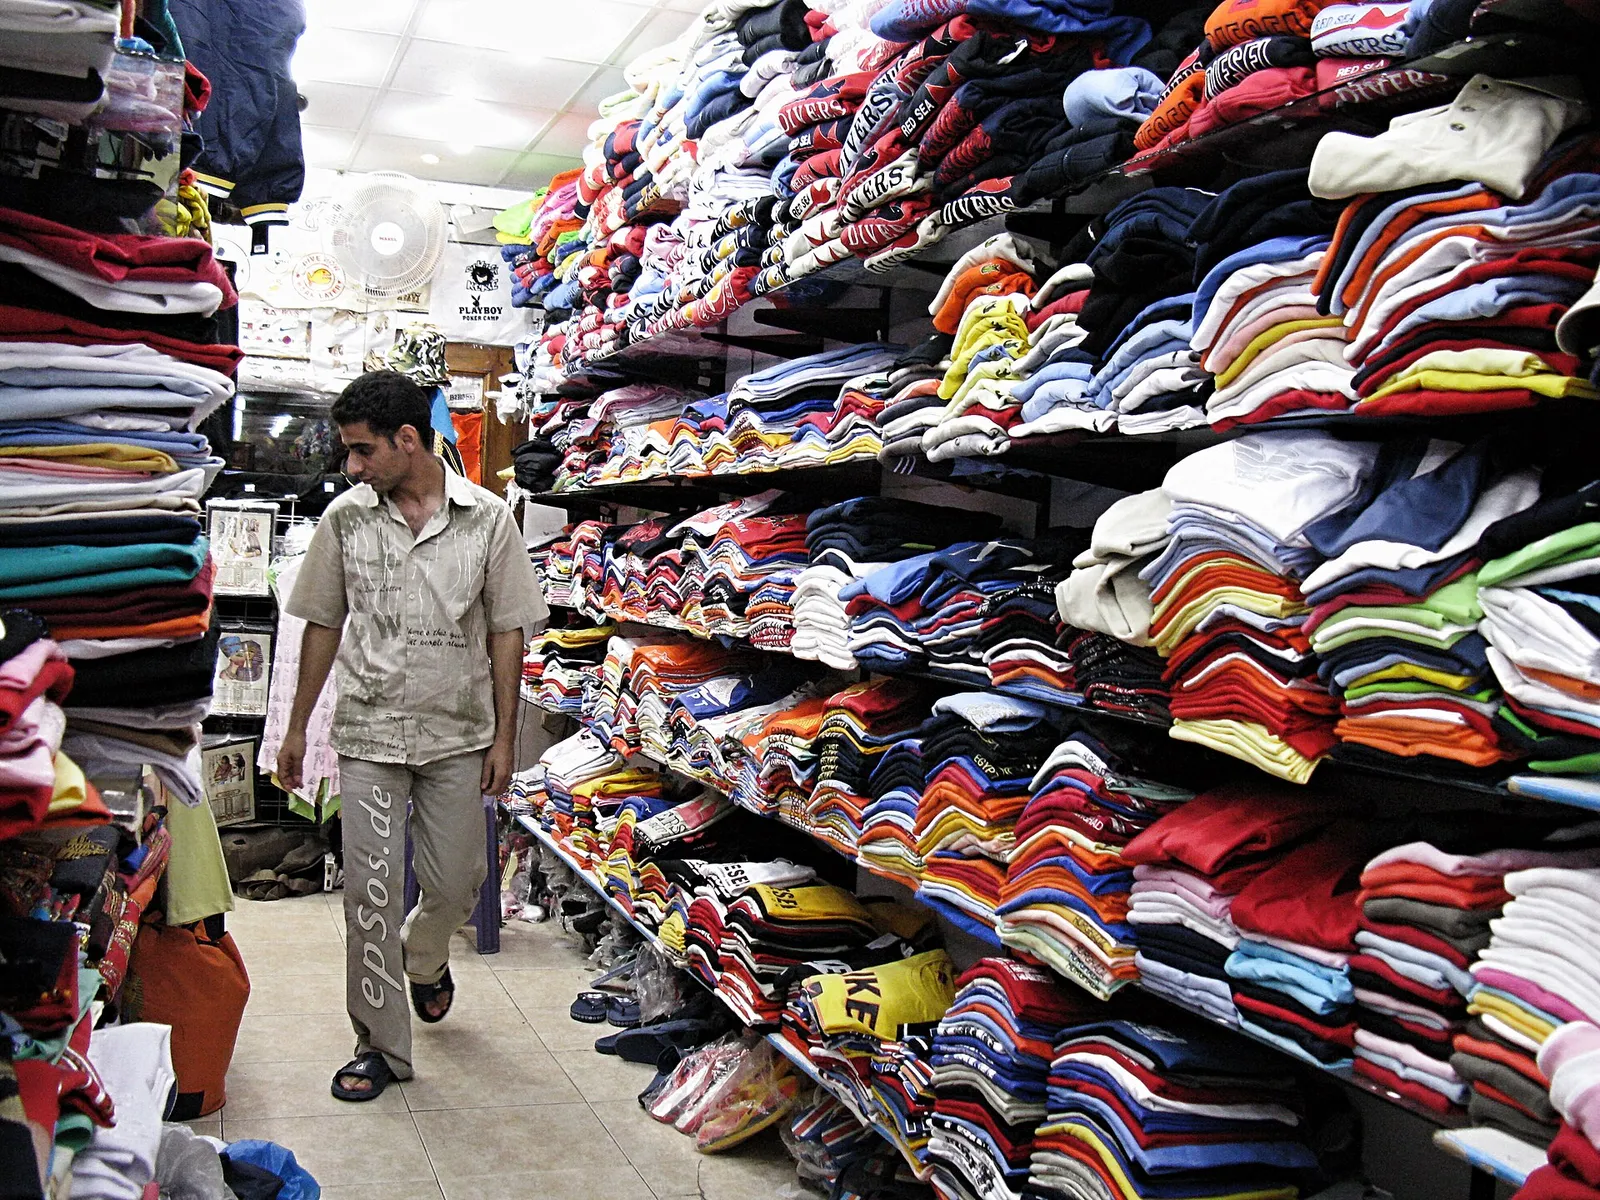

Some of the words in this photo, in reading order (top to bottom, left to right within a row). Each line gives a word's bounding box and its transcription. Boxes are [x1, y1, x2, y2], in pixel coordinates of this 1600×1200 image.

[1315, 17, 1334, 31] RED
[1334, 14, 1356, 24] SEA
[1314, 33, 1403, 56] DIVERS
[1336, 65, 1360, 78] RED
[778, 100, 847, 133] DIVERS
[901, 119, 918, 137] RED
[916, 100, 936, 120] SEA
[840, 92, 893, 178] DIVERS
[319, 285, 341, 298] LATER
[459, 306, 503, 315] PLAYBOY
